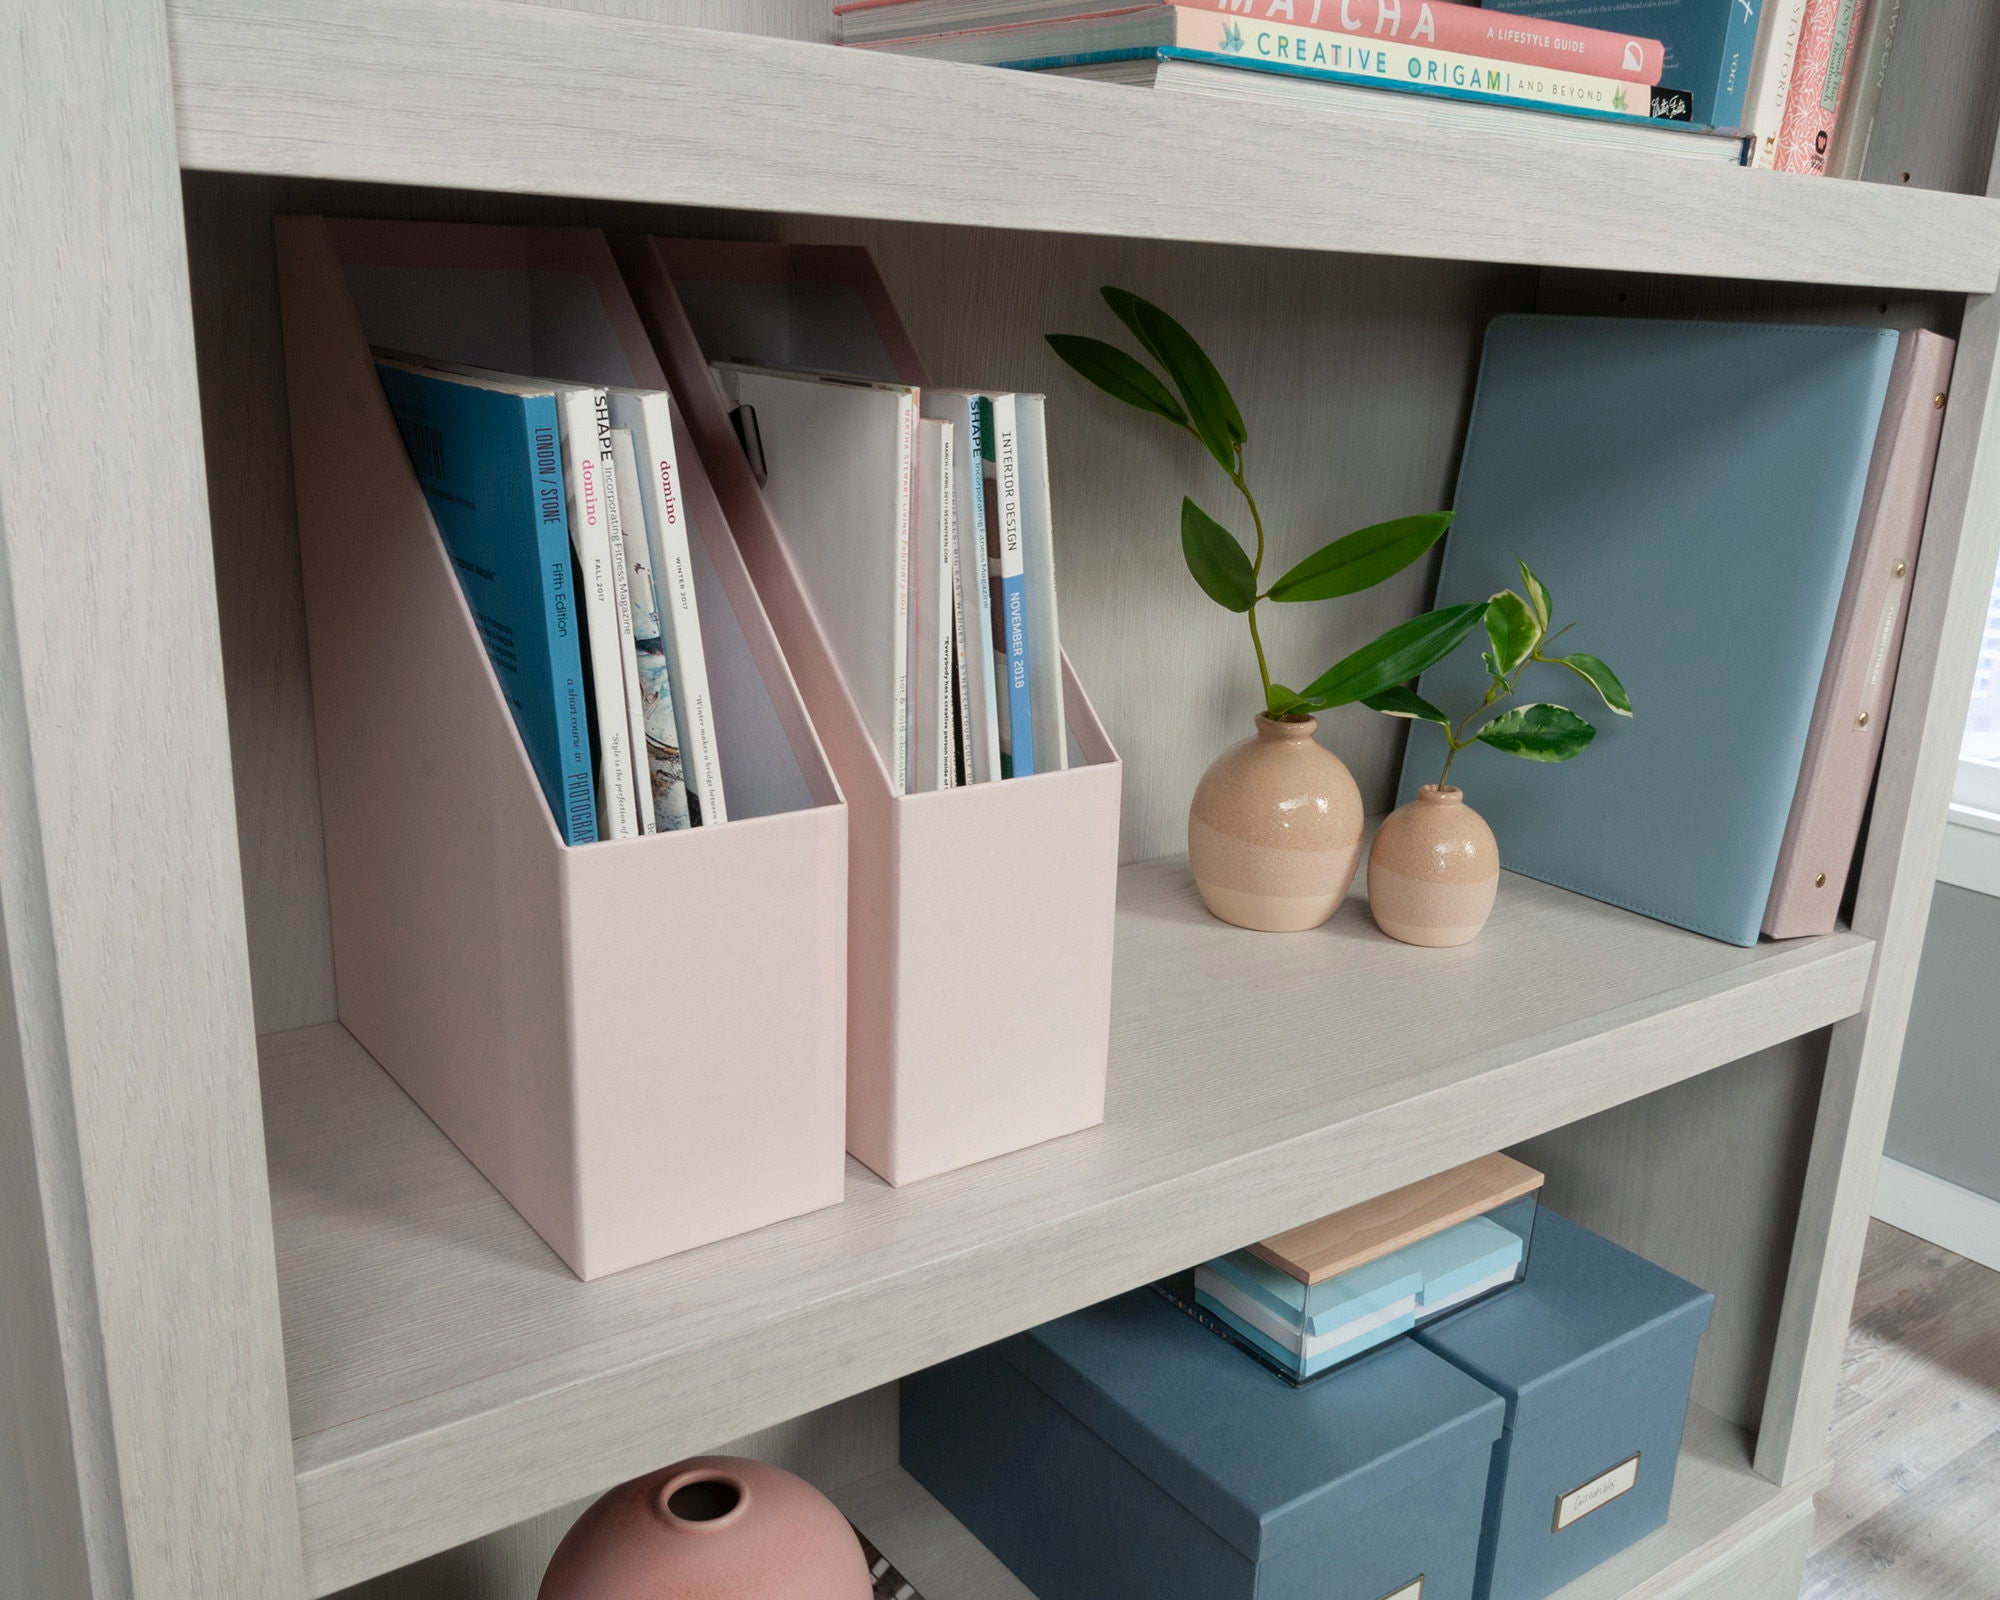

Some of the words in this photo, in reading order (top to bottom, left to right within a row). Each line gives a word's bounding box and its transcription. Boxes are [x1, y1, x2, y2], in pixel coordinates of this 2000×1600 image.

[1487, 27, 1494, 39] A
[1498, 29, 1550, 48] LIFESTYLE
[1554, 39, 1584, 53] GUIDE
[1775, 6, 1801, 107] STAFFORD
[1257, 32, 1387, 73] CREATIVE
[1408, 57, 1510, 92] ORIGAMI
[1518, 79, 1543, 93] AND
[1552, 83, 1602, 102] BEYOND
[594, 396, 614, 462] SHAPE
[903, 409, 911, 449] MARTHA
[970, 401, 982, 458] SHAPE
[535, 427, 556, 474] LONDON
[1001, 431, 1015, 498] INTERIOR
[581, 459, 597, 526] domino
[659, 460, 676, 525] domino
[902, 454, 910, 497] STEWART
[975, 462, 986, 527] Incorporating
[541, 488, 561, 524] STONE
[604, 467, 620, 542] Incorporating
[901, 503, 909, 536] LIVING
[977, 527, 987, 564] Fitness
[1005, 502, 1017, 551] DESIGN
[552, 563, 563, 591] Fifth
[615, 542, 626, 581] Fitness
[676, 556, 685, 591] WINTER
[899, 541, 908, 590] February
[680, 592, 688, 610] 2017
[980, 565, 989, 609] Magazine
[554, 593, 568, 638] Edition
[618, 583, 631, 635] Magazine
[1010, 591, 1024, 657] NOVEMBER
[898, 675, 906, 694] hot
[1013, 661, 1025, 689] 2018
[568, 686, 578, 716] short
[571, 717, 582, 752] course
[700, 729, 710, 754] makes
[575, 753, 583, 763] in
[615, 767, 623, 780] the
[705, 761, 714, 788] bridge
[898, 737, 906, 788] chocolate
[615, 782, 627, 824] perfection
[709, 788, 718, 821] between
[619, 824, 629, 835] of
